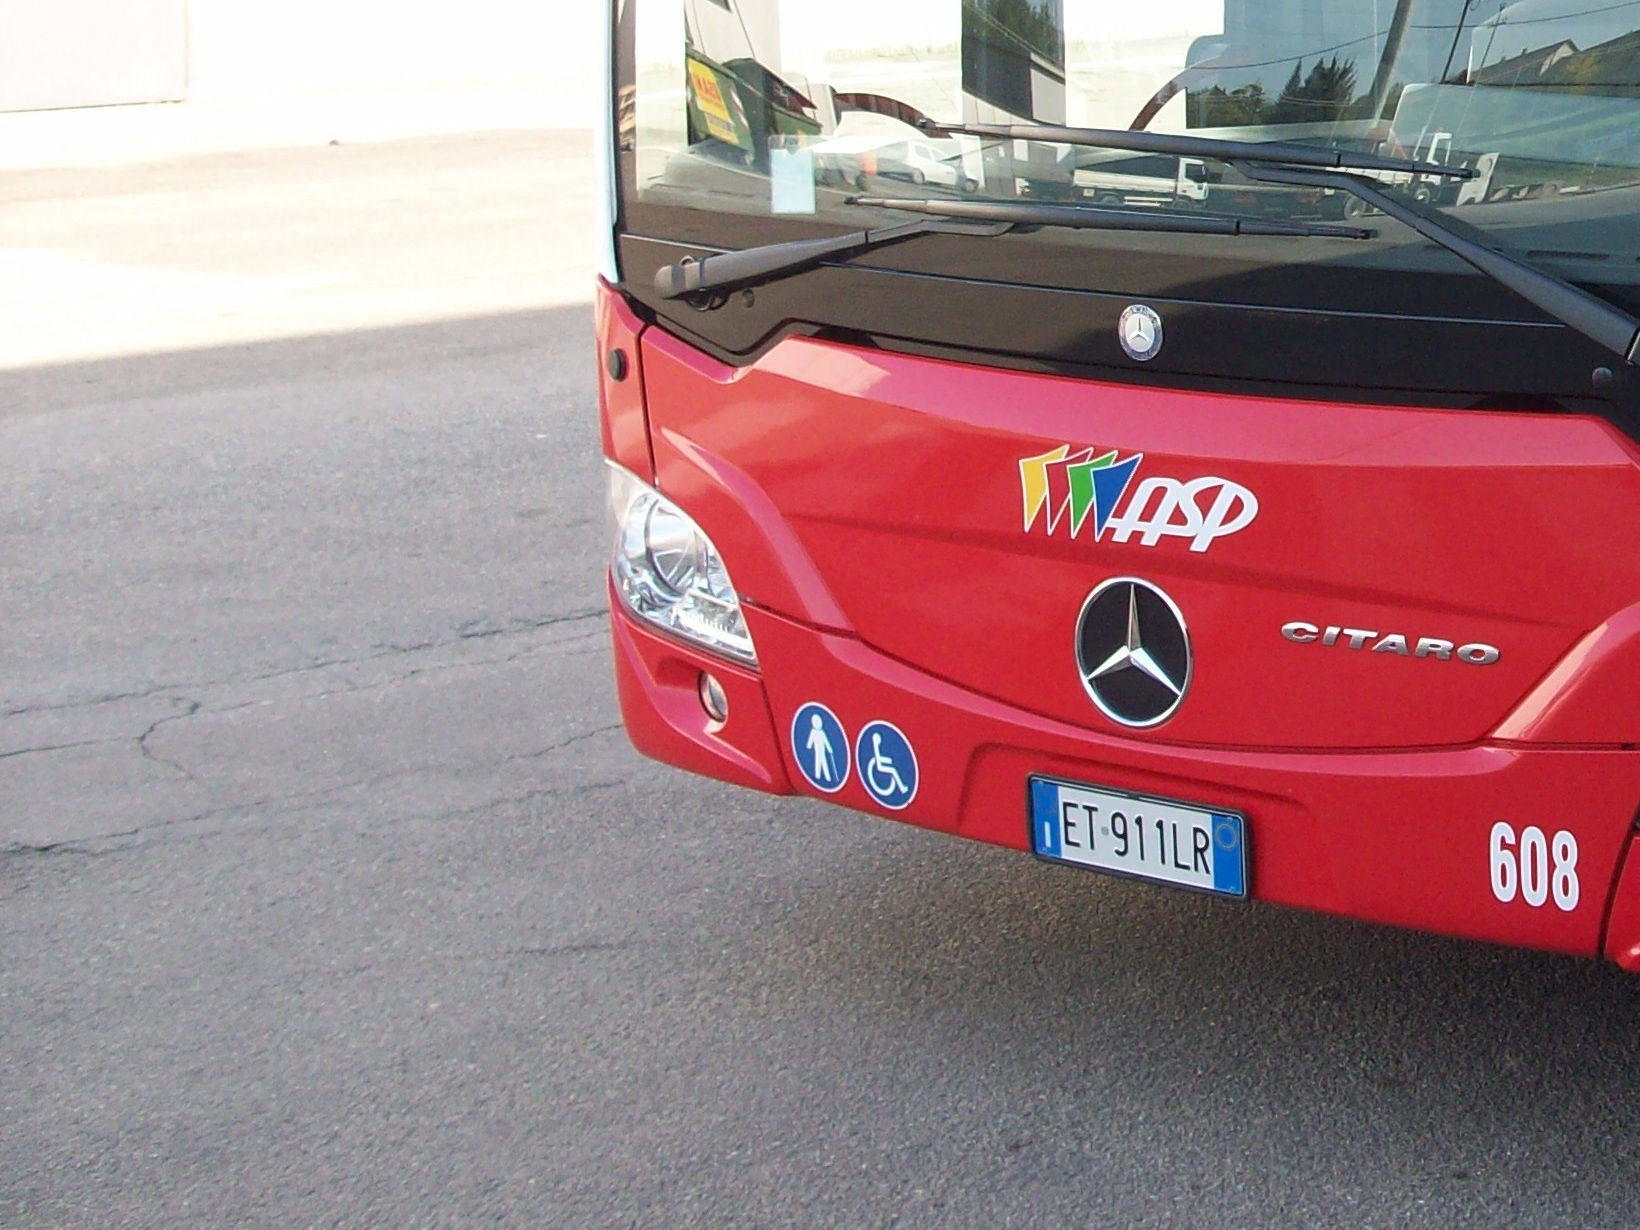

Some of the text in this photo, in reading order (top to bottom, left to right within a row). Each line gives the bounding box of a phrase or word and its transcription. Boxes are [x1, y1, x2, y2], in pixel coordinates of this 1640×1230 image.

[1105, 476, 1259, 552] ASP
[1281, 621, 1499, 665] CITARO
[1489, 821, 1580, 911] 608
